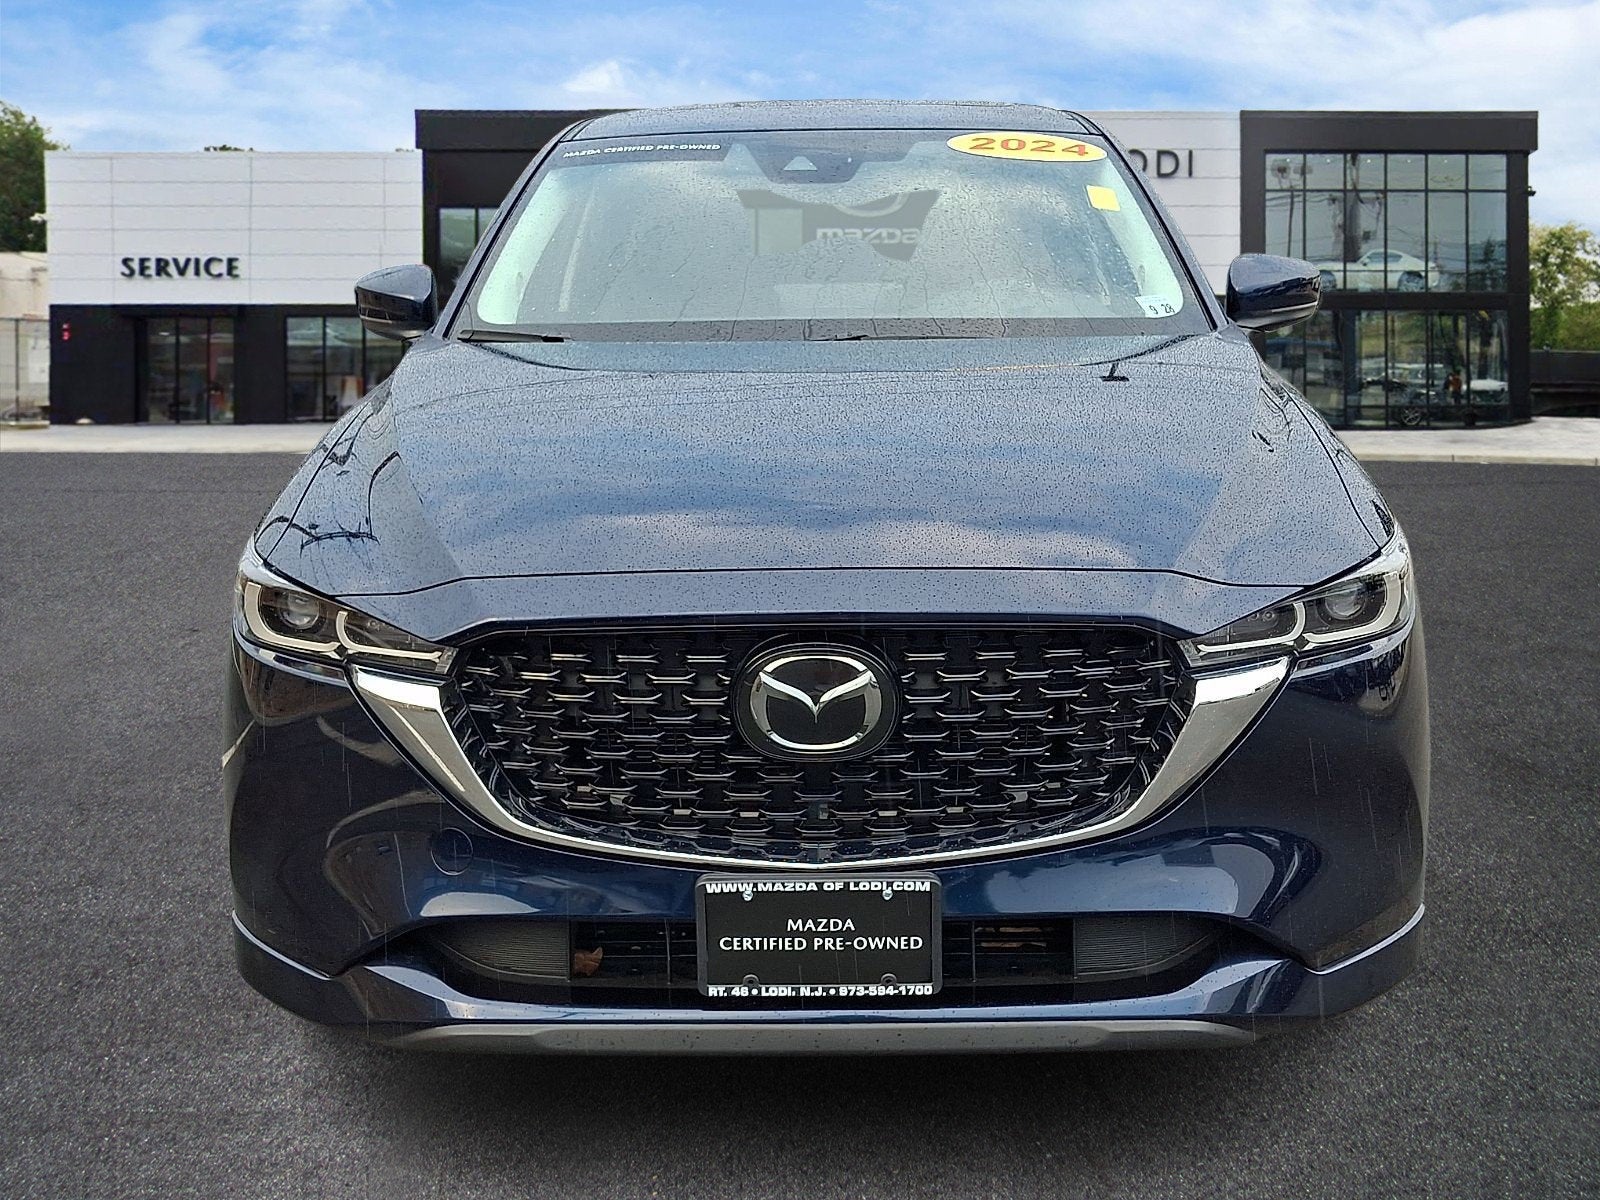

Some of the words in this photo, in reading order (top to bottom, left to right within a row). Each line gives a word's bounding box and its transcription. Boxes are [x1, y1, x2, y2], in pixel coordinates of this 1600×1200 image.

[563, 149, 601, 158] MAZDA
[604, 145, 654, 154] CERTIFIED
[969, 137, 1089, 156] 2024
[121, 257, 240, 279] SERVICE
[705, 882, 818, 894] WWW.MAZDA
[823, 882, 844, 892] OF
[849, 881, 931, 892] LODI.COM
[786, 918, 856, 932] MAZDA
[719, 937, 807, 951] CERTIFIED
[813, 936, 923, 951] PRE-OWNED
[708, 987, 728, 997] RT.
[731, 987, 749, 997] 46
[800, 987, 827, 997] N.J.
